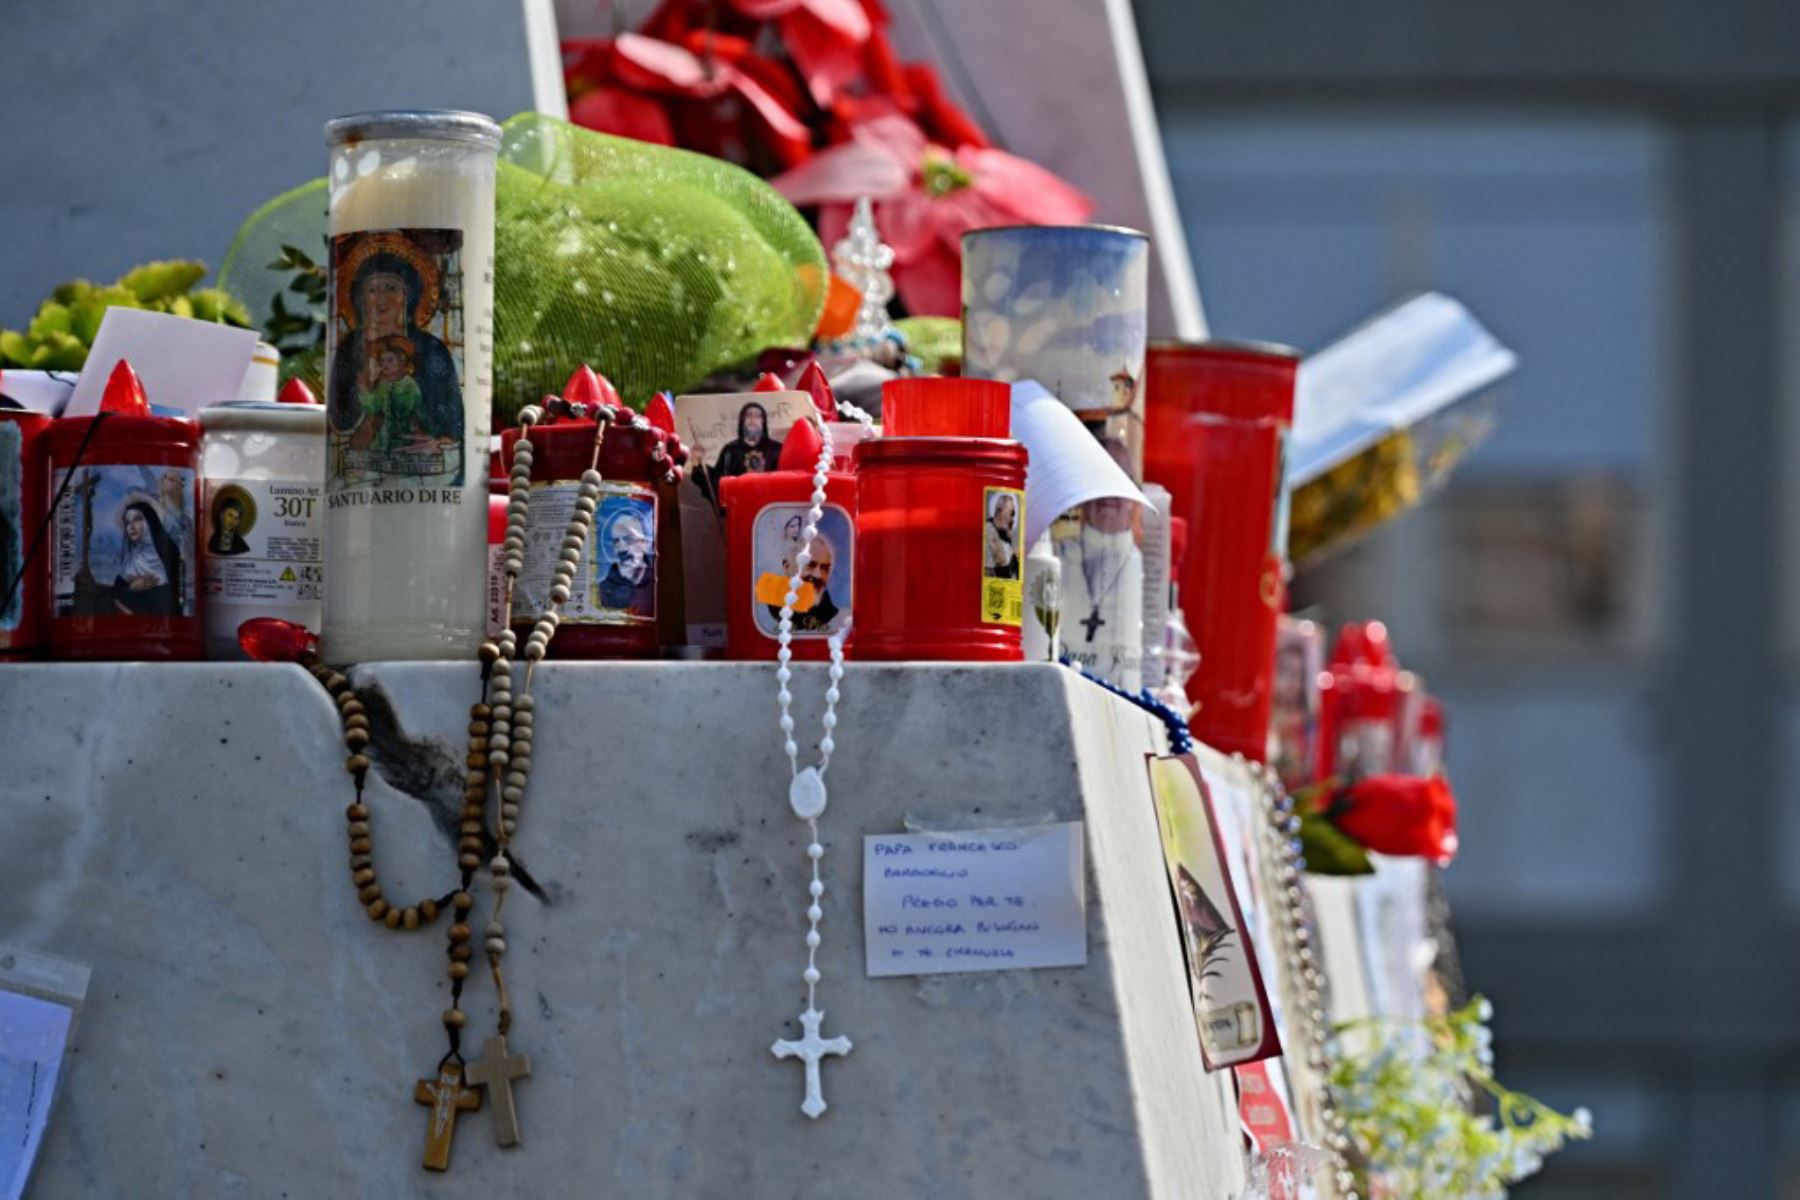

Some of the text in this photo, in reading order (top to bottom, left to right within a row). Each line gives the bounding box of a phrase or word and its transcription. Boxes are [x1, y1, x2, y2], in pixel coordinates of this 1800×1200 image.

[269, 484, 305, 495] Lumino
[328, 489, 414, 509] SANTUARIO
[419, 489, 437, 504] DI
[272, 497, 317, 518] 30T
[875, 843, 913, 856] PAPA
[905, 924, 965, 936] ANCORA
